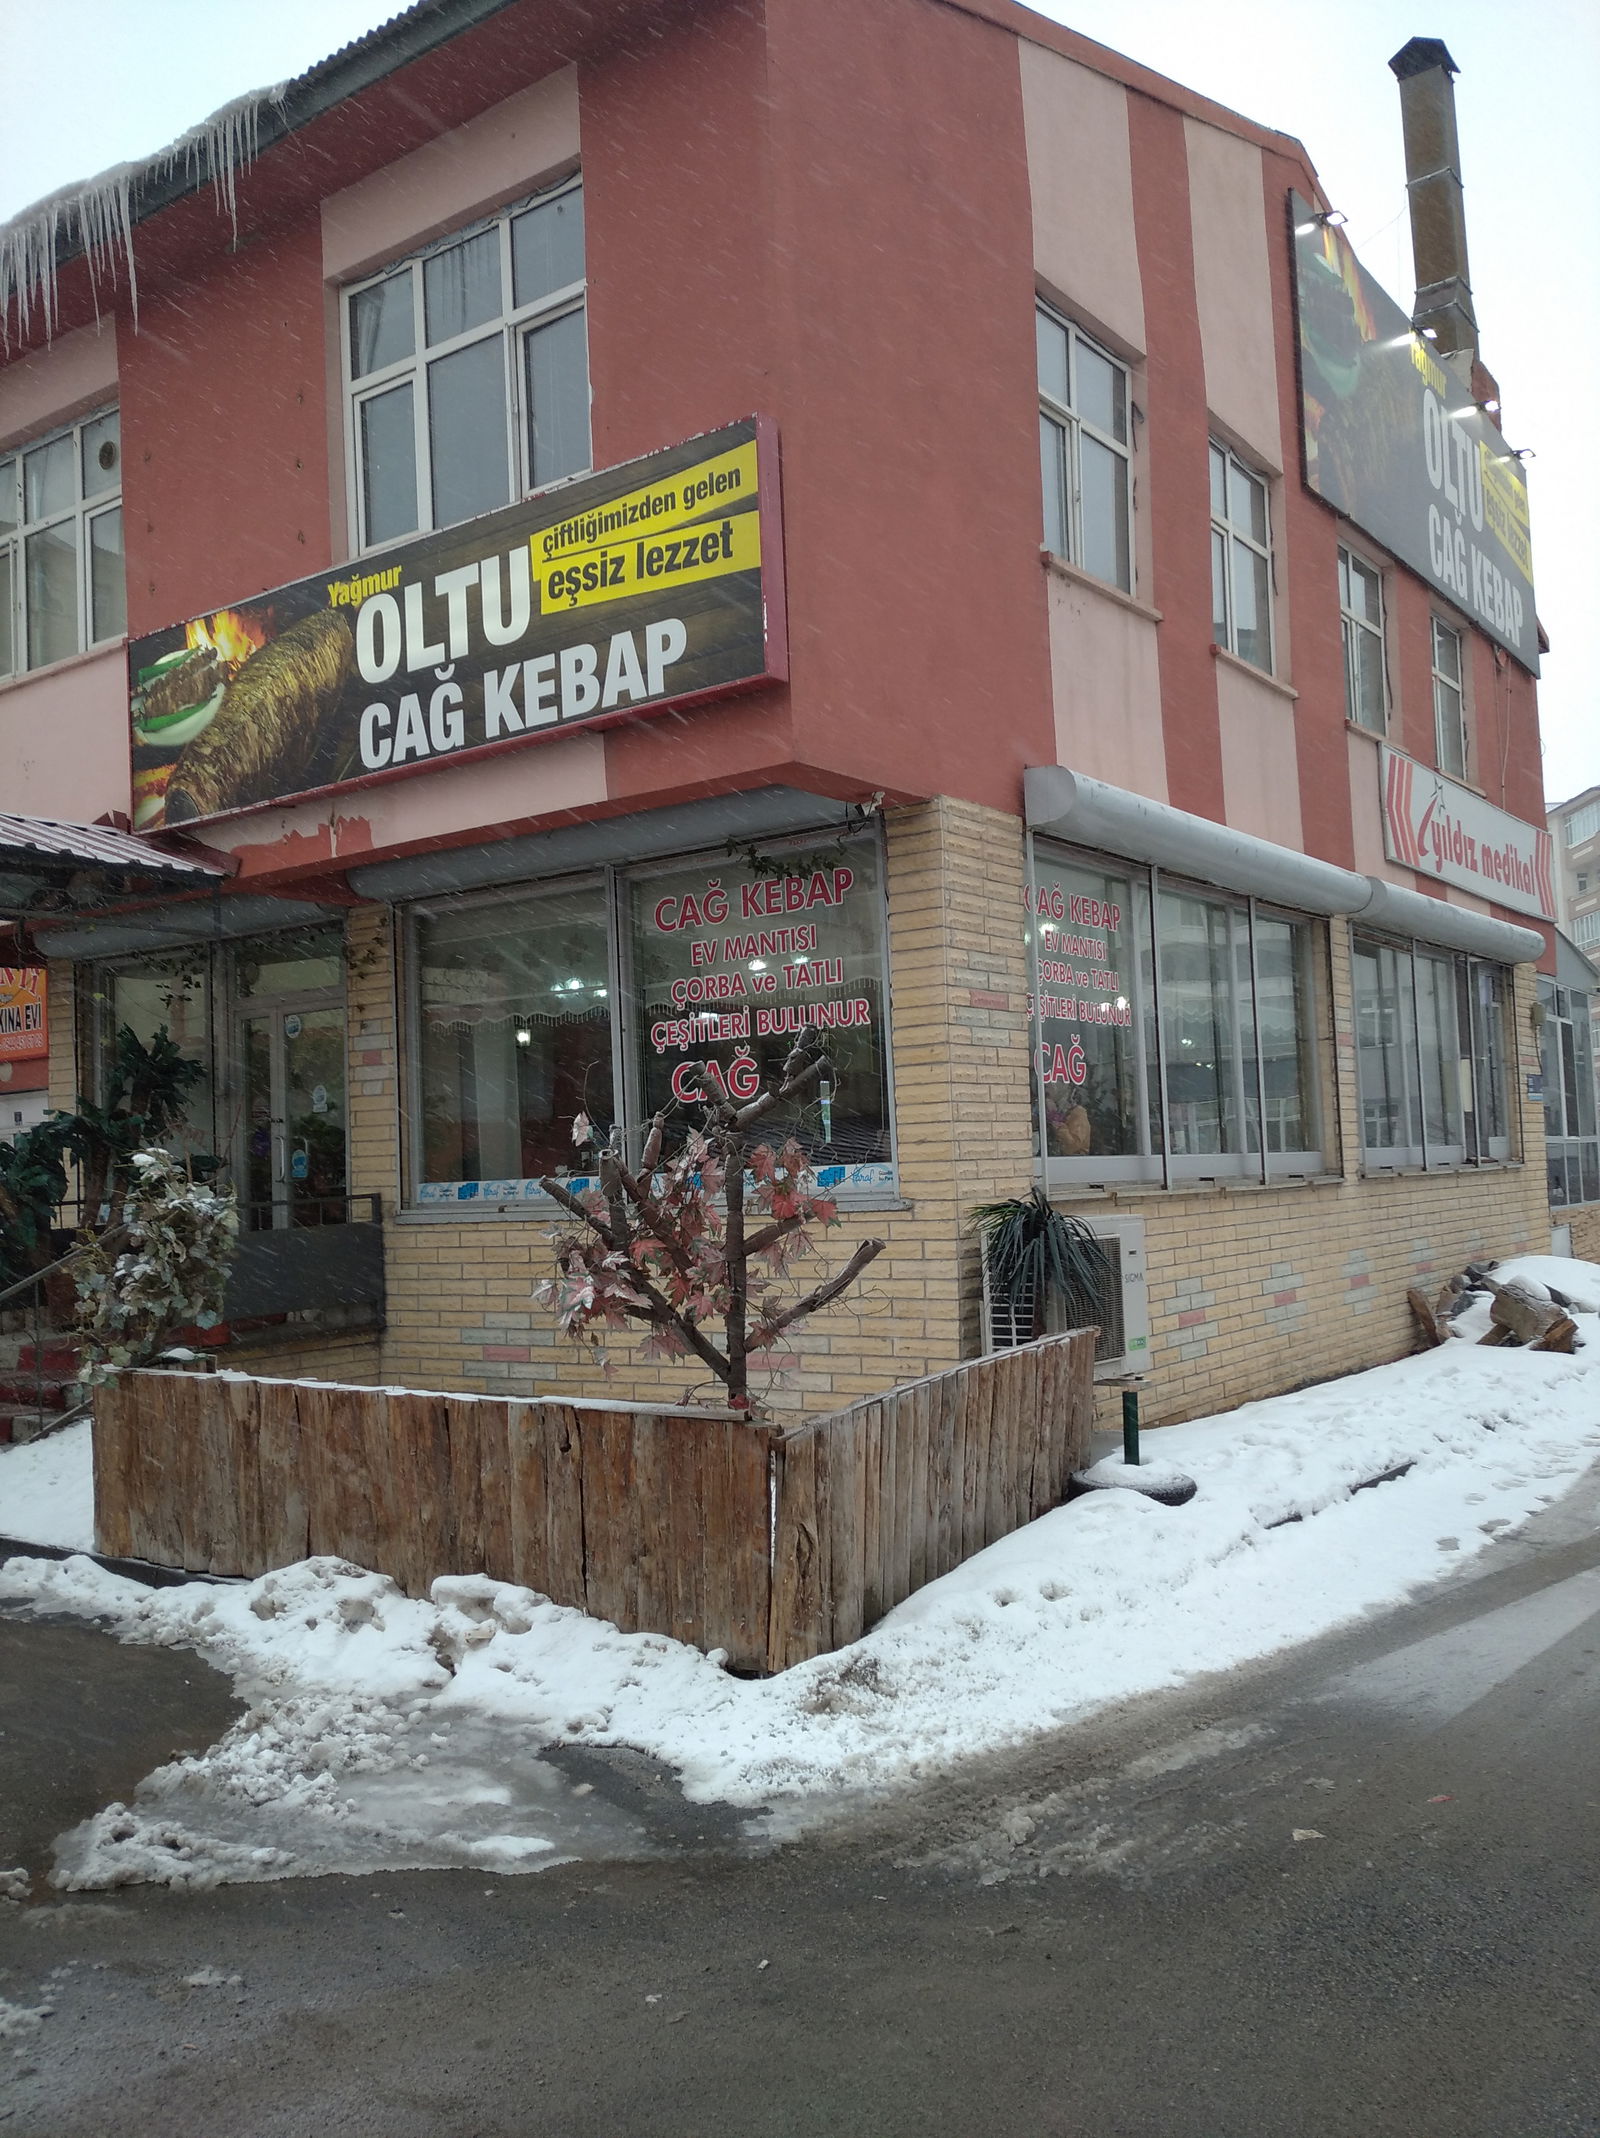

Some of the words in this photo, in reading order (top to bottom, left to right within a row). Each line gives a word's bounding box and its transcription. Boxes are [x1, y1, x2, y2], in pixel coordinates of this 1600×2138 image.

[1423, 388, 1485, 533] OLTU
[541, 489, 677, 562] çiftliğimizden
[682, 465, 742, 511] gelen
[327, 563, 403, 608] Yağmur
[546, 549, 626, 607] eşsiz
[635, 520, 732, 579] lezzet
[1429, 503, 1468, 601] CAĞ
[1471, 543, 1524, 648] KEBAP
[355, 545, 532, 684] OLTU
[359, 660, 465, 770] CAĞ
[483, 618, 688, 739] KEBAP
[653, 877, 730, 933] CAĞ
[741, 868, 854, 919] KEBAP
[1069, 893, 1121, 933] KEBAP
[691, 940, 718, 967] EV
[723, 923, 818, 962] MANTISI
[1044, 929, 1059, 952] EV
[1061, 932, 1107, 962] MANTISI
[671, 971, 747, 1012] ÇORBA
[752, 974, 777, 995] ve
[783, 957, 844, 990] TATLI
[1075, 970, 1089, 988] ve
[1091, 967, 1120, 993] TATLI
[650, 1004, 751, 1054] ÇEŞİTLERİ
[757, 997, 872, 1036] BULUNUR
[1079, 1000, 1133, 1027] BULUNUR
[1034, 1034, 1087, 1086] CAĞ
